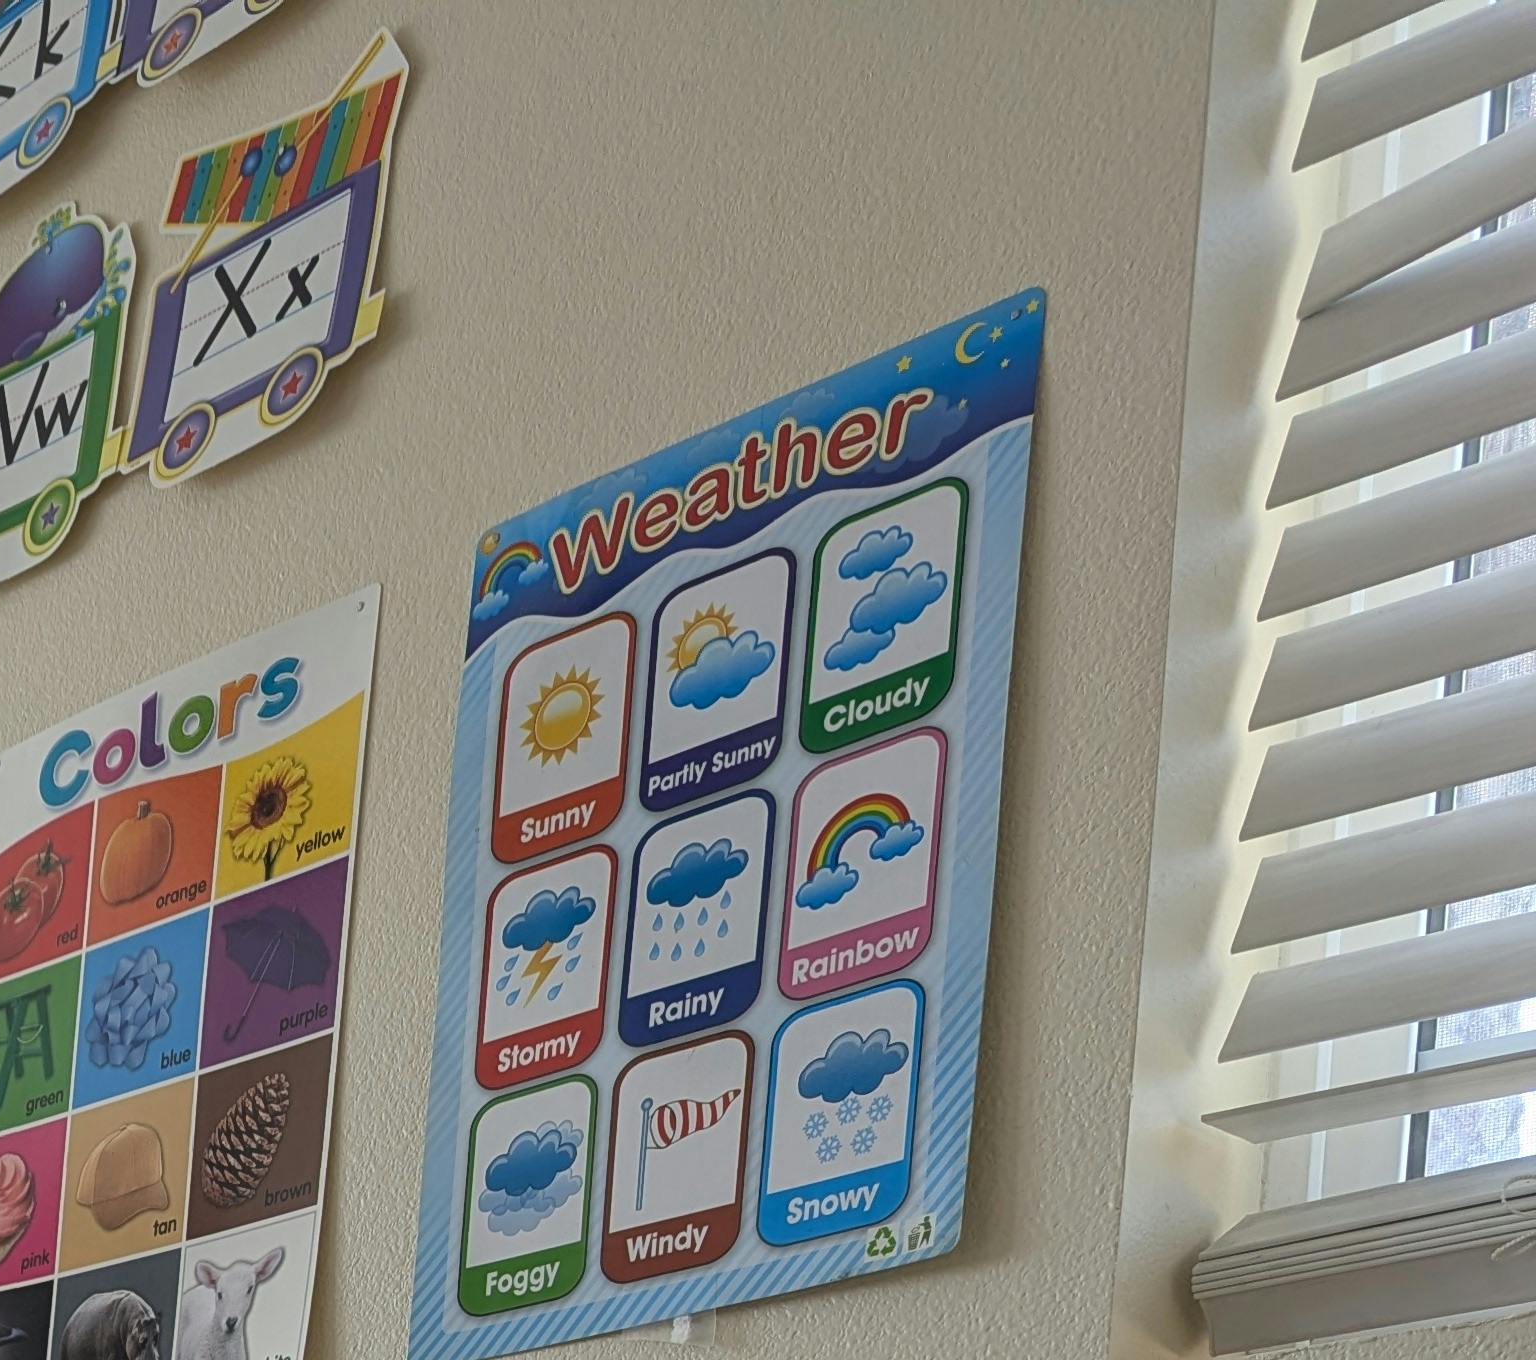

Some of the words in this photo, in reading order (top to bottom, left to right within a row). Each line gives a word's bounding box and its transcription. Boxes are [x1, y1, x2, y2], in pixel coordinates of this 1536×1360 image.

[192, 238, 319, 367] Xx
[549, 388, 933, 594] Weather
[824, 676, 930, 732] Cloudy
[38, 657, 302, 807] Colors
[648, 757, 705, 796] Partly
[712, 735, 776, 777] Sunny
[521, 801, 596, 843] Sunny
[295, 826, 346, 860] yellow
[155, 880, 207, 911] orange
[56, 925, 78, 948] red
[791, 927, 920, 987] Rainbow
[279, 1003, 328, 1037] purple
[648, 987, 725, 1029] Rainy
[161, 1047, 191, 1070] blue
[497, 1031, 582, 1073] Stormy
[26, 1088, 64, 1116] green
[264, 1180, 312, 1208] brown
[787, 1182, 881, 1227] Snowy
[153, 1217, 177, 1237] tan
[627, 1223, 710, 1263] Windy
[20, 1250, 50, 1273] pink
[484, 1260, 561, 1299] Foggy
